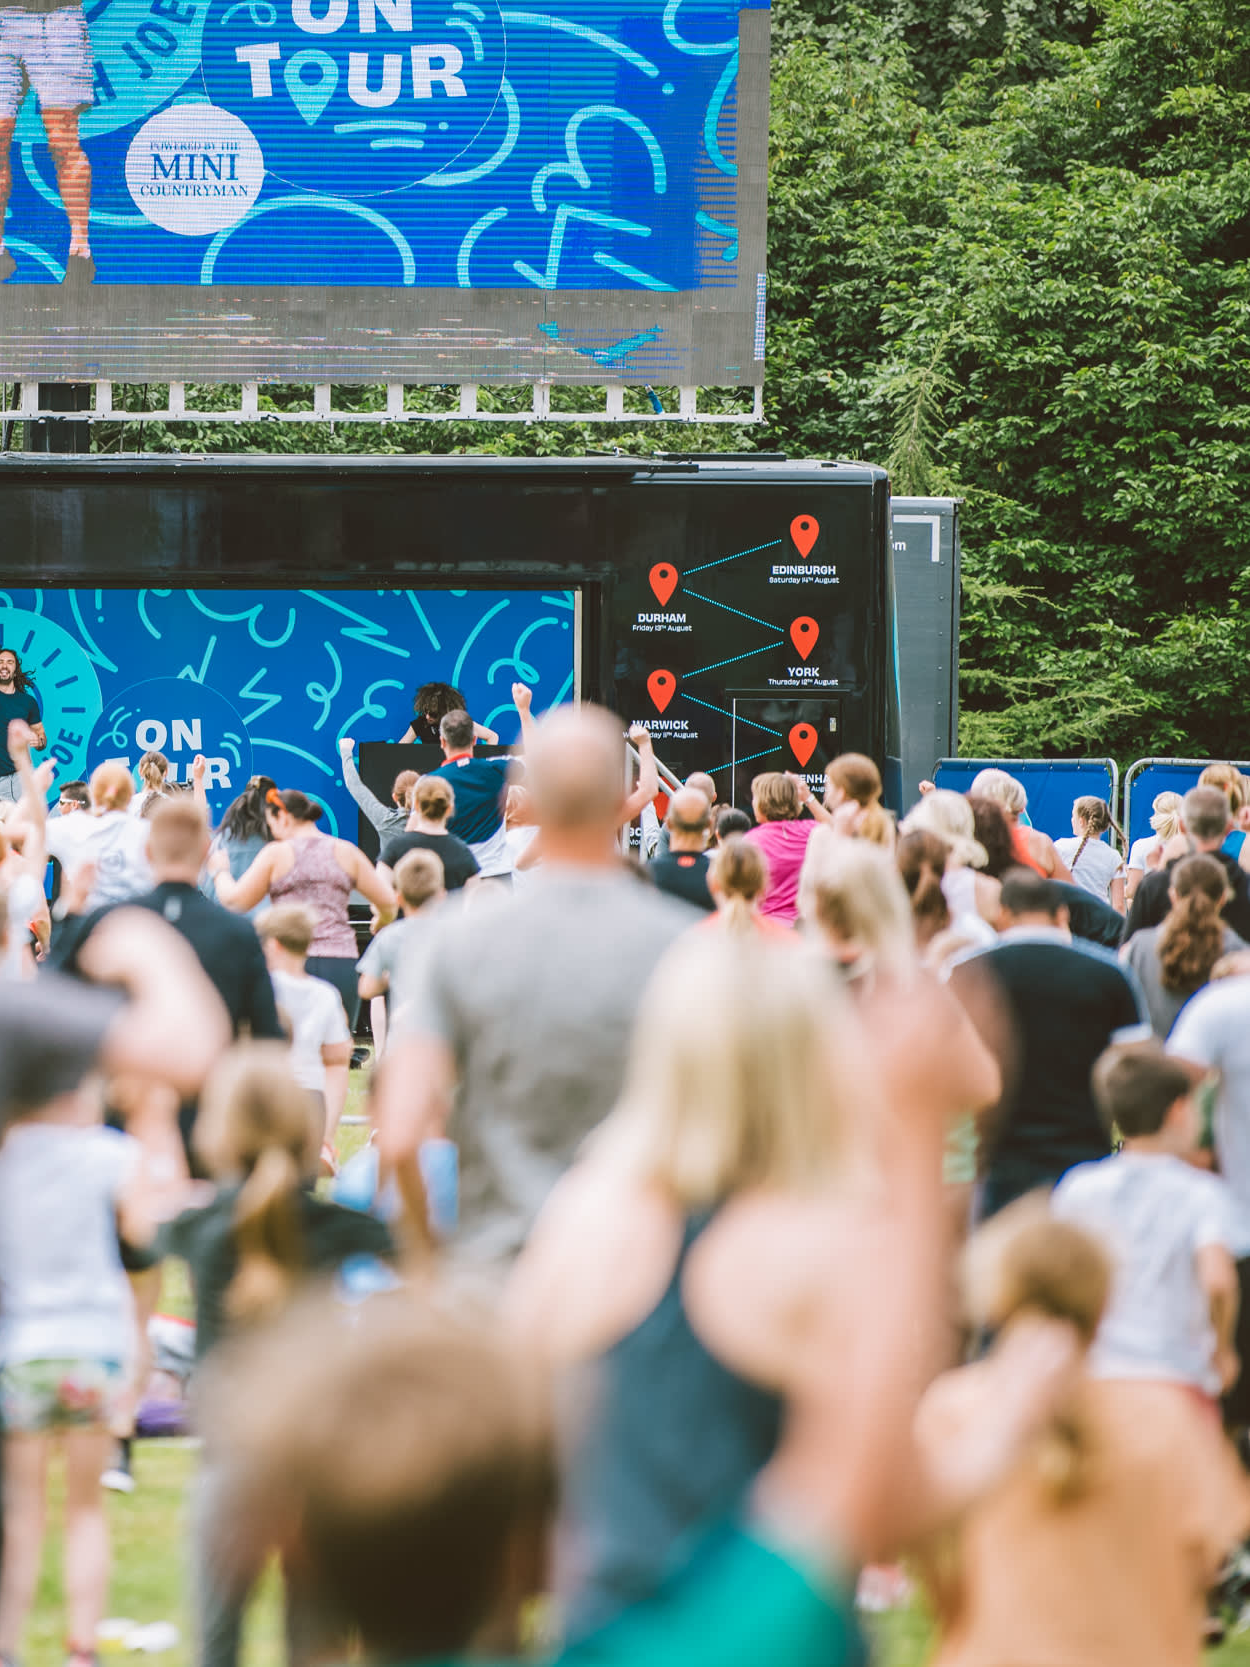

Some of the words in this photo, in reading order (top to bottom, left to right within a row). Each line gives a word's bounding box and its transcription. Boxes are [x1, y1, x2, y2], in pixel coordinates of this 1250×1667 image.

[291, 0, 413, 34] ON
[122, 0, 197, 80] JOE
[235, 42, 467, 126] TOUR
[149, 141, 202, 150] POWERED
[203, 141, 216, 150] BY
[220, 141, 241, 150] THE
[150, 153, 240, 180] MINI
[140, 184, 248, 197] COUNTRYMAN
[772, 565, 836, 575] EDINBURGH
[769, 576, 801, 584] Saturday
[814, 576, 840, 584] August
[637, 613, 687, 623] DURHAM
[632, 624, 654, 632] Friday
[667, 624, 692, 632] August
[787, 667, 820, 677] YORK
[768, 678, 800, 686] Thursday
[813, 678, 839, 686] August
[135, 718, 203, 752] ON
